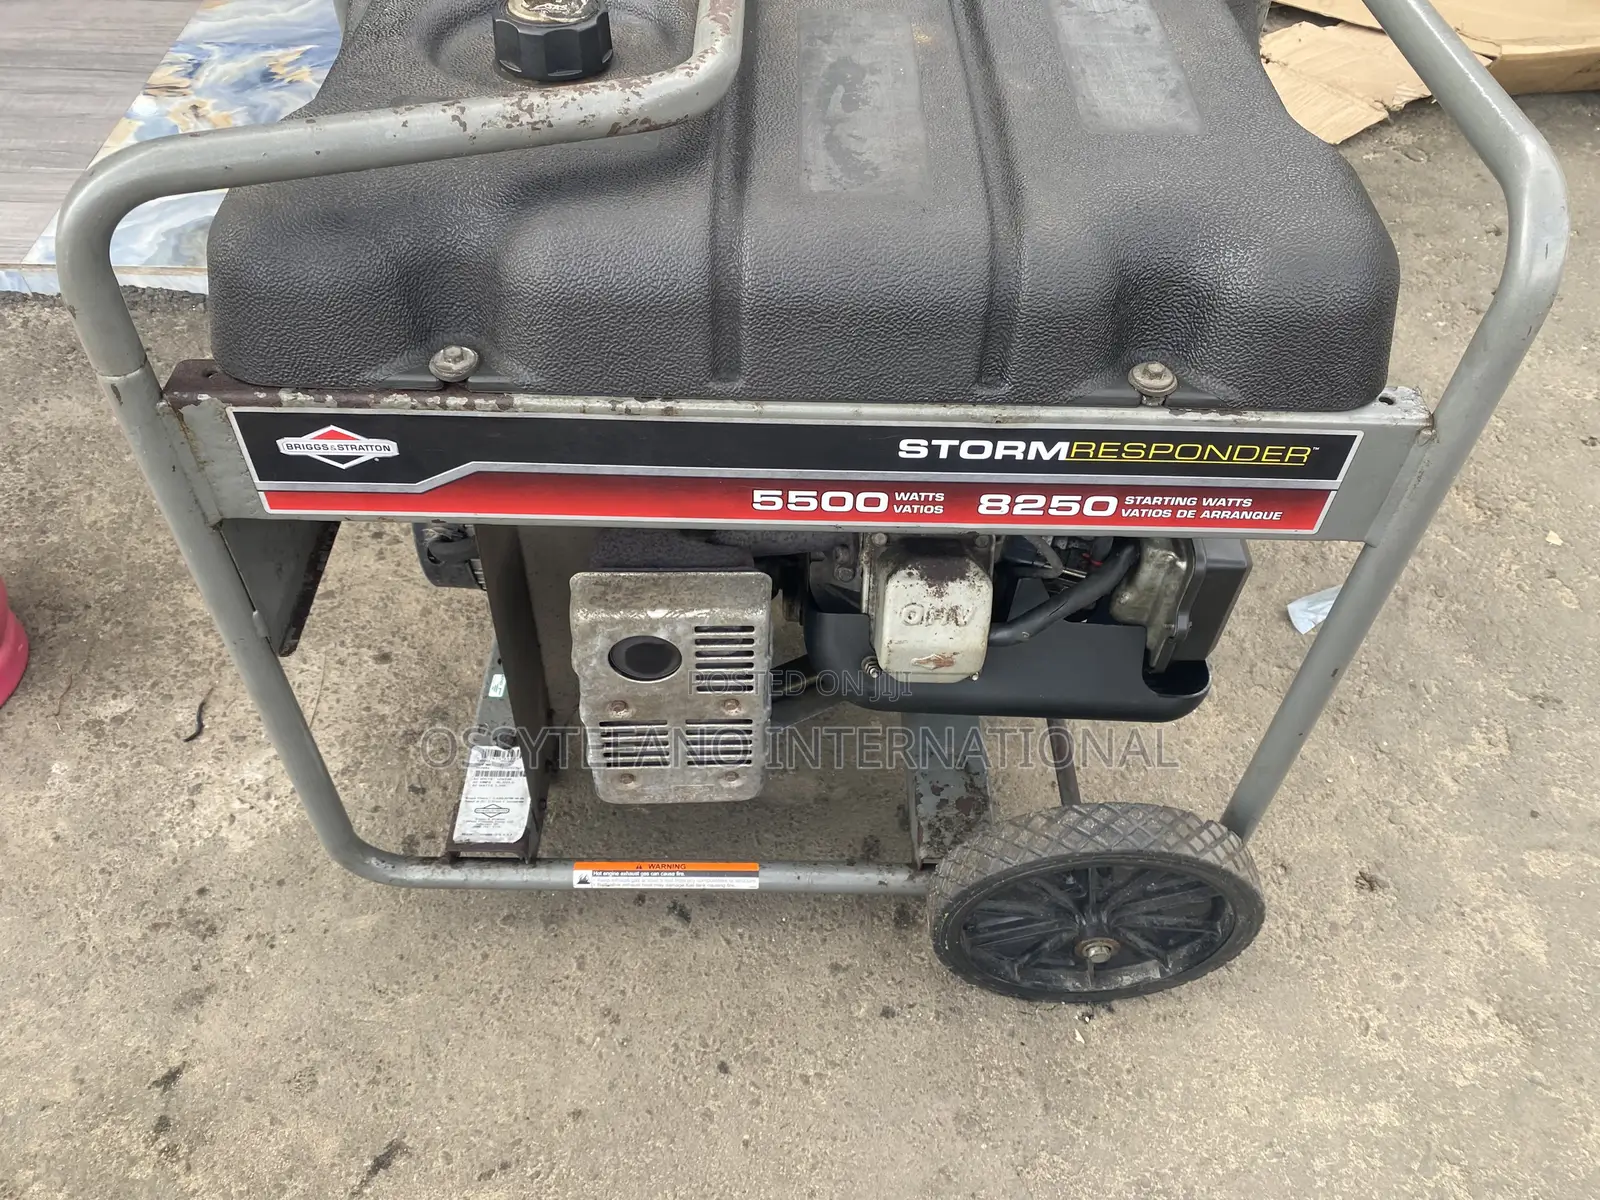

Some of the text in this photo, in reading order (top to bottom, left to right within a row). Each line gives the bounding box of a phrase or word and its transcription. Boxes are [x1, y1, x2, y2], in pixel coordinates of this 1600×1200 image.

[752, 489, 889, 513] 5500
[894, 492, 945, 502] WATTS
[1124, 496, 1252, 507] STARTING WATTS
[893, 504, 944, 514] VATIOS
[977, 494, 1118, 517] 8250
[1121, 509, 1283, 520] VATIOS DE ARRANQUE
